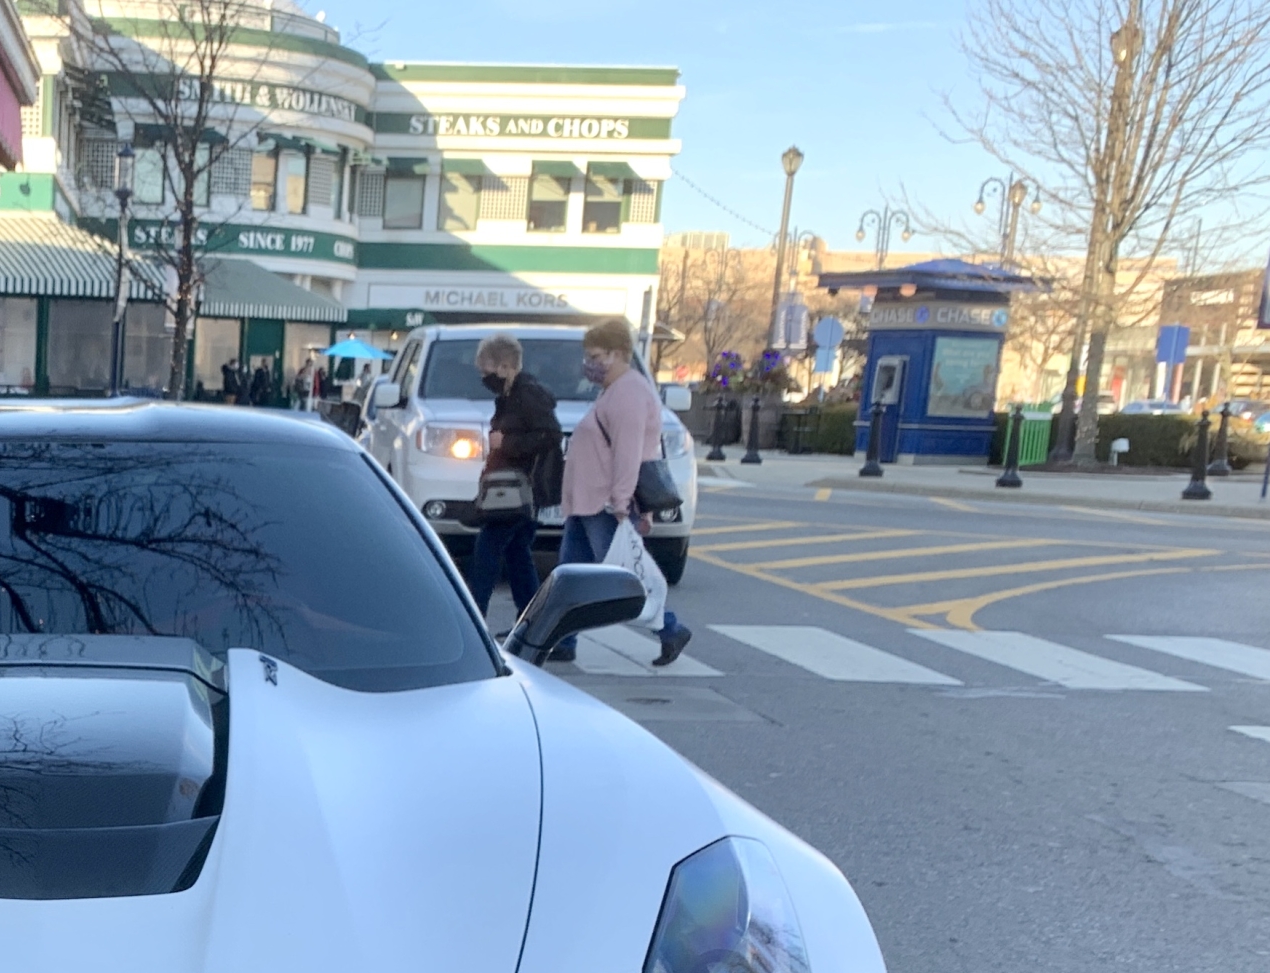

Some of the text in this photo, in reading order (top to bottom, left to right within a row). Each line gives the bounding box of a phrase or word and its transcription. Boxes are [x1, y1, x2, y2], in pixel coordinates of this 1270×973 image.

[256, 84, 272, 107] &
[409, 114, 629, 139] STEAKS AND CHOPS
[238, 230, 284, 251] SINCE
[290, 235, 315, 253] 1977
[424, 290, 569, 308] MICHAEL KORS
[936, 307, 992, 325] CHASE
